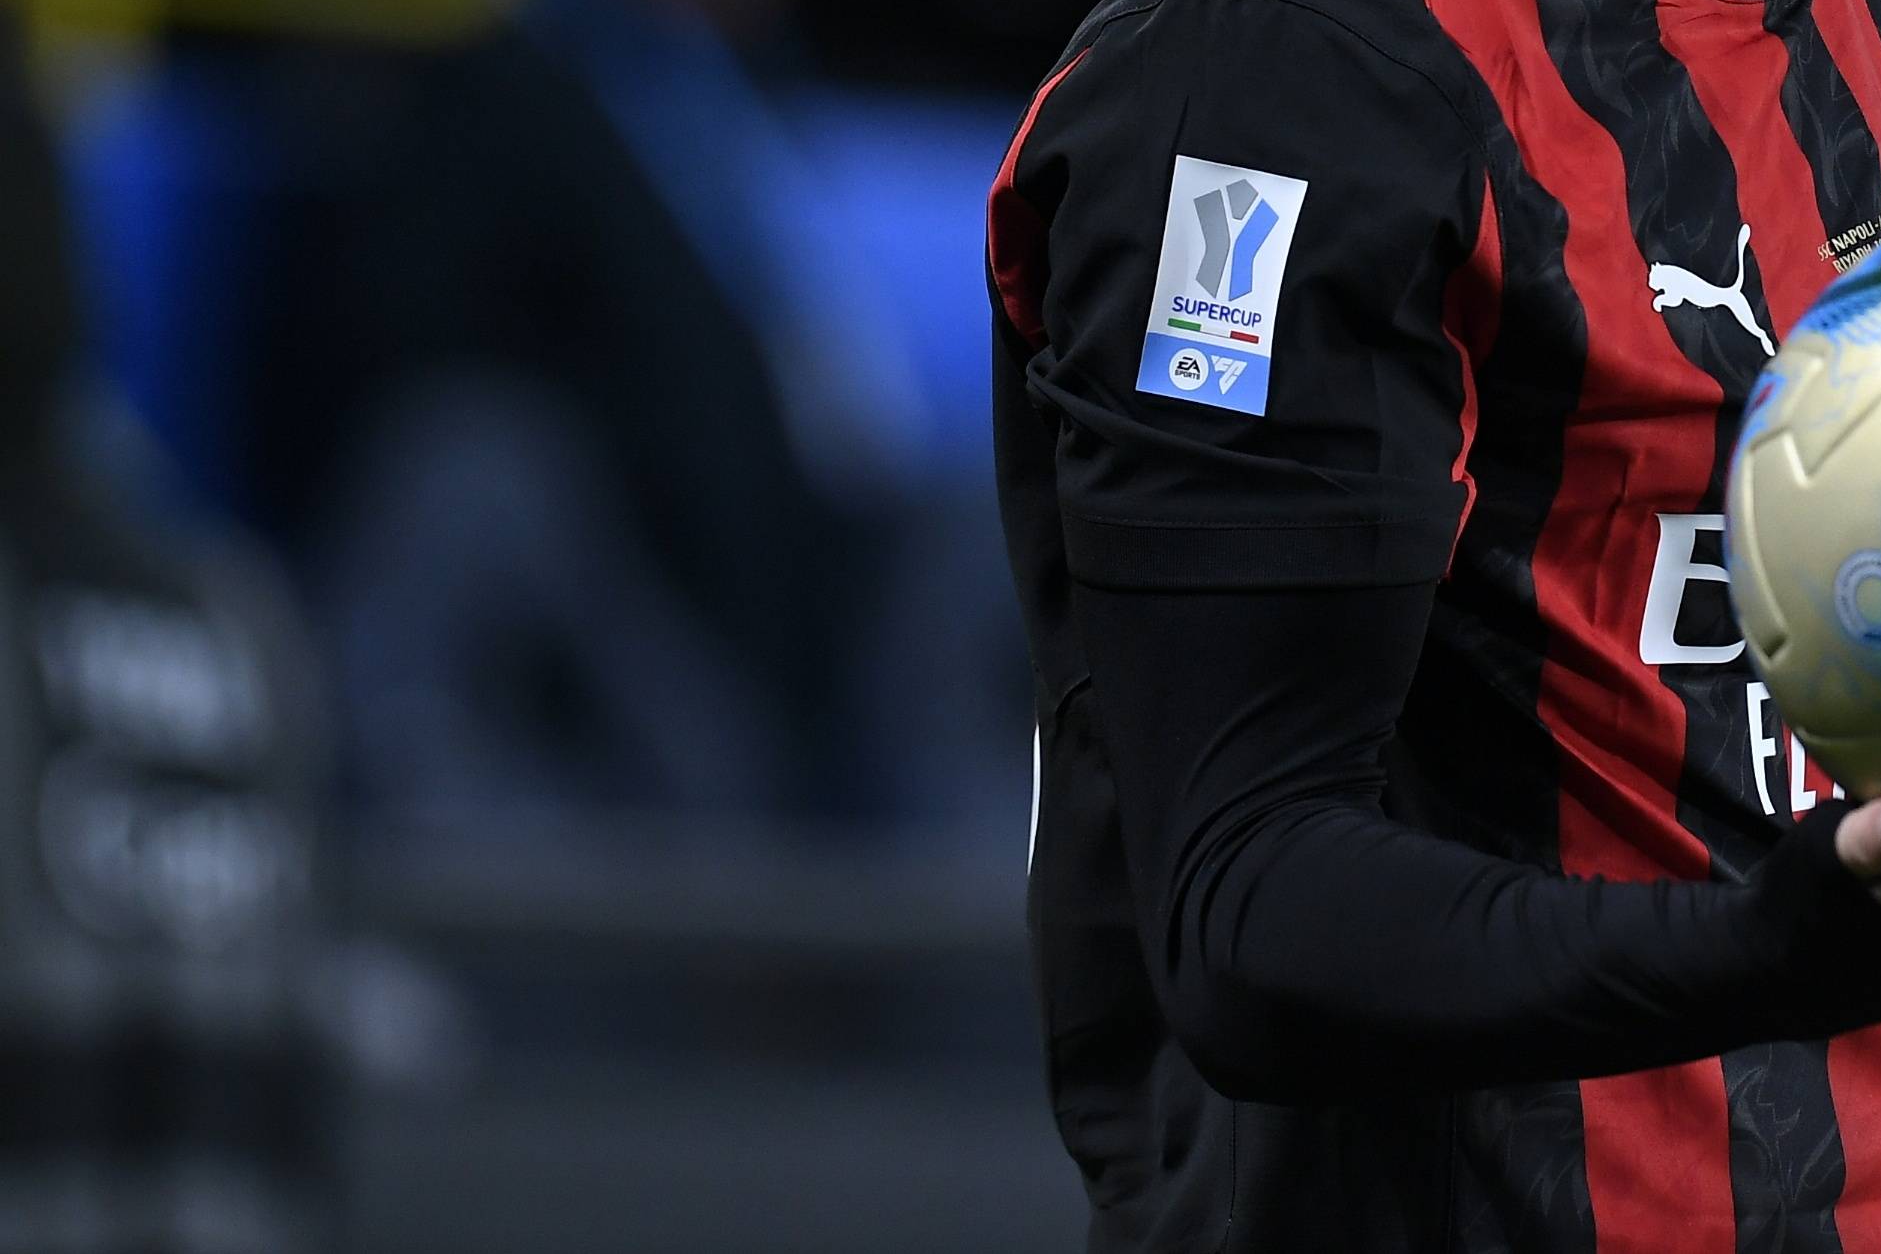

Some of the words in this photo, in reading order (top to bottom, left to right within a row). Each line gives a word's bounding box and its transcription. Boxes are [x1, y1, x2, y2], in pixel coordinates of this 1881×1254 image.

[1817, 240, 1836, 262] SSC
[1831, 220, 1876, 252] NAPOLI
[1172, 295, 1262, 328] SUPERCUP
[1174, 369, 1201, 381] SPORTS
[1177, 356, 1201, 373] EA
[1746, 682, 1845, 816] FL
